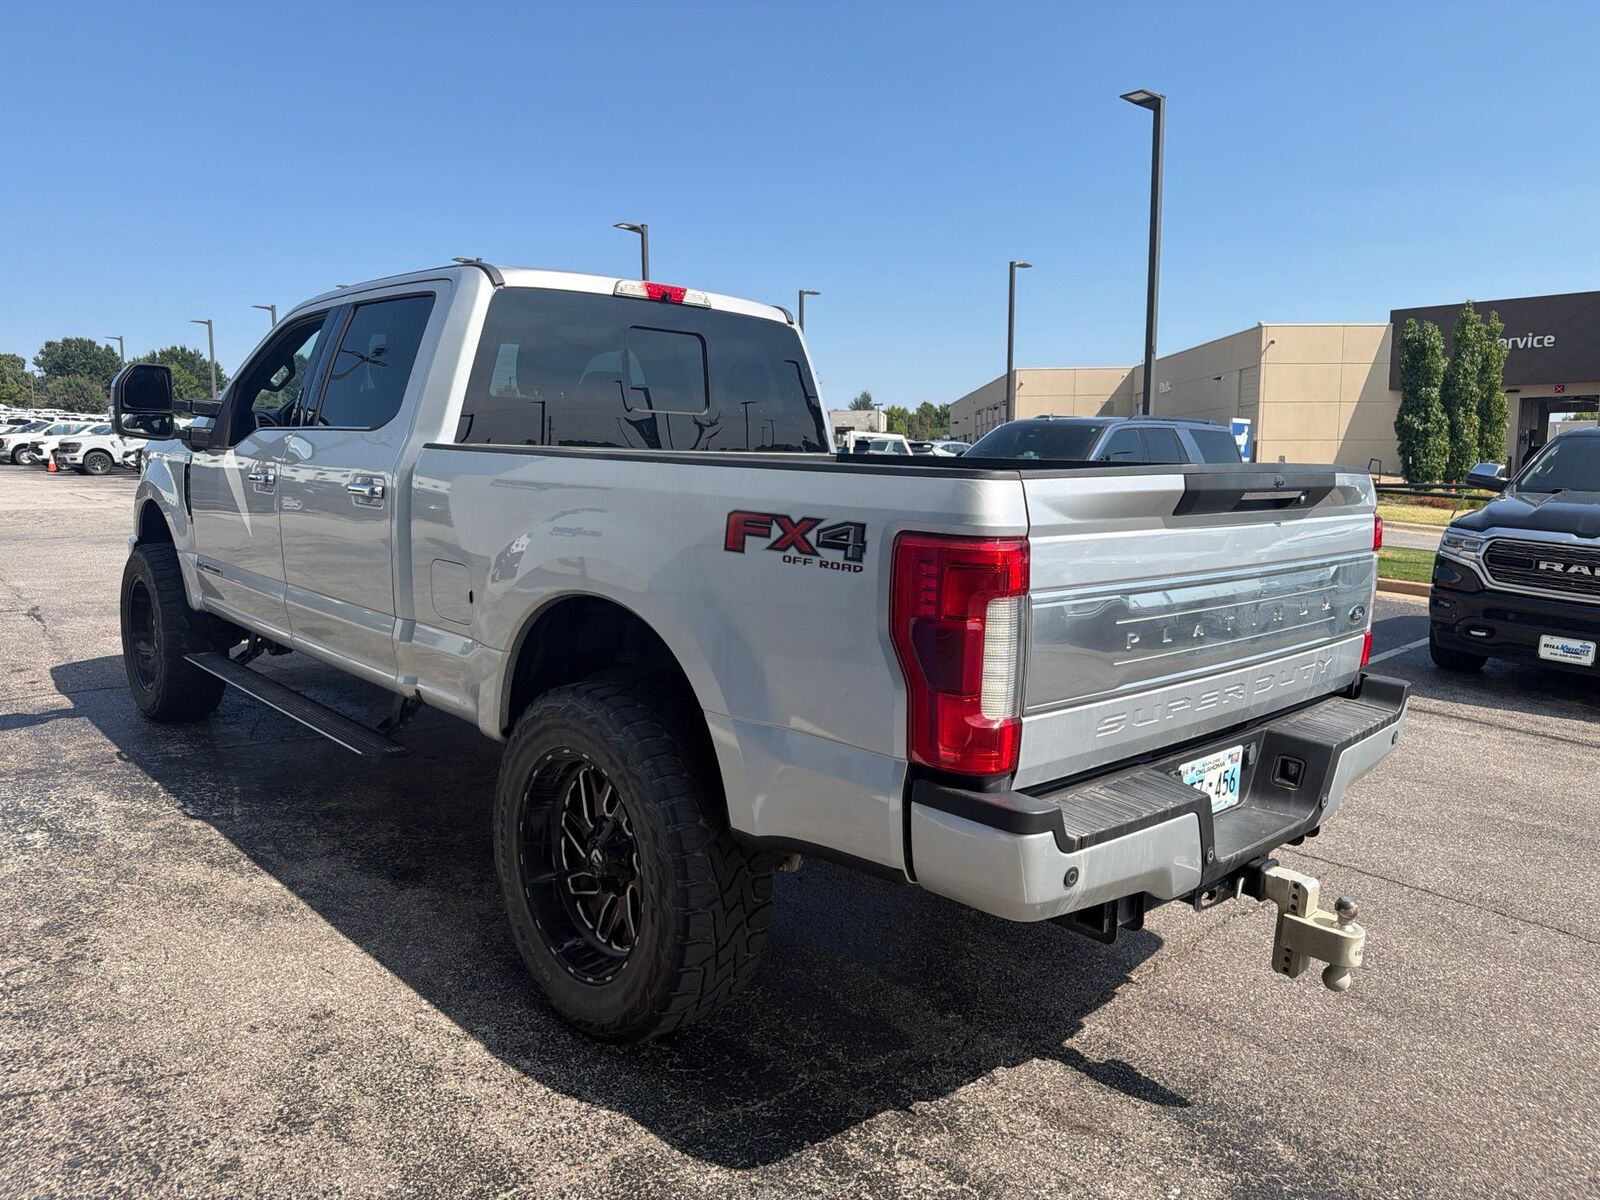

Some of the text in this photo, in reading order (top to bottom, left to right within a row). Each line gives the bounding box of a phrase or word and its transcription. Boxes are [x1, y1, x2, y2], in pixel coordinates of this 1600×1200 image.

[724, 510, 866, 563] FX4
[782, 555, 864, 573] OFF ROAD
[1538, 560, 1600, 576] RA
[1126, 598, 1332, 650] PLATINUM
[1096, 656, 1333, 738] SUPER DUTY
[1195, 761, 1226, 776] OKLAHOMA
